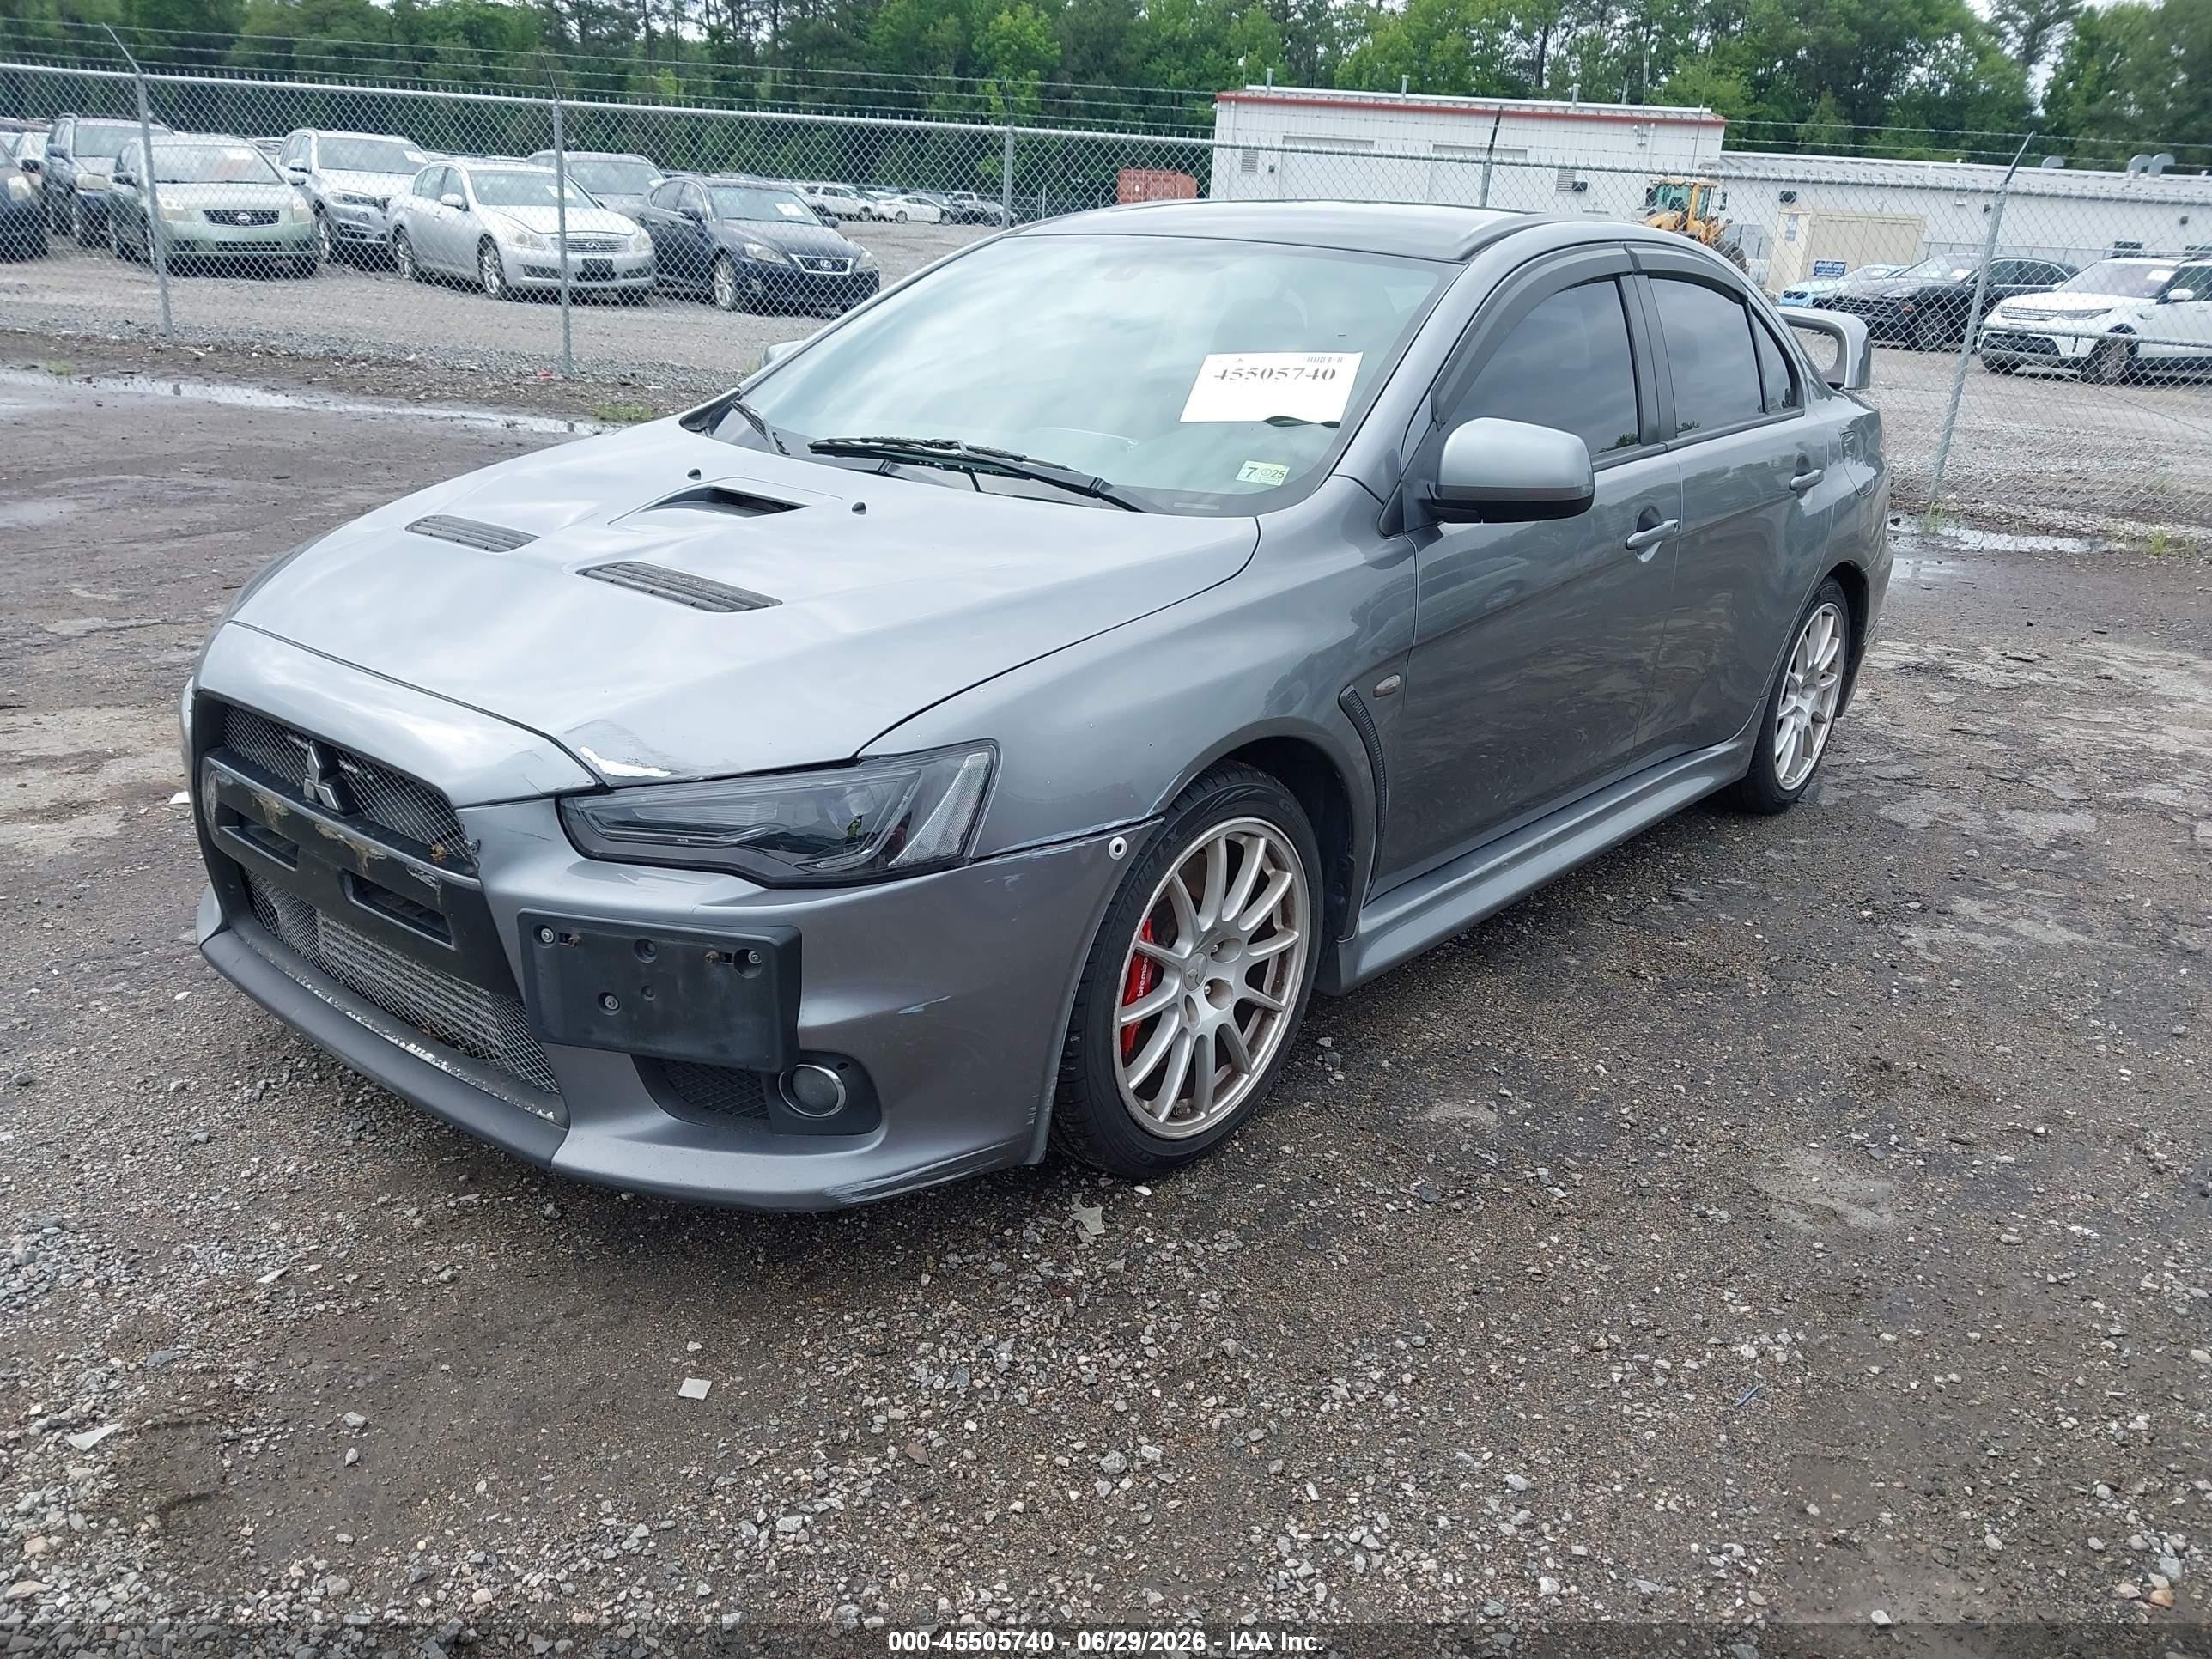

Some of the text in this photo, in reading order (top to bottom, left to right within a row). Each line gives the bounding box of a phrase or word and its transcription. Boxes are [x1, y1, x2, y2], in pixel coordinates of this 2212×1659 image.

[1213, 368, 1336, 380] 45505740
[1246, 466, 1286, 479] 7 25
[1137, 957, 1148, 997] brembo
